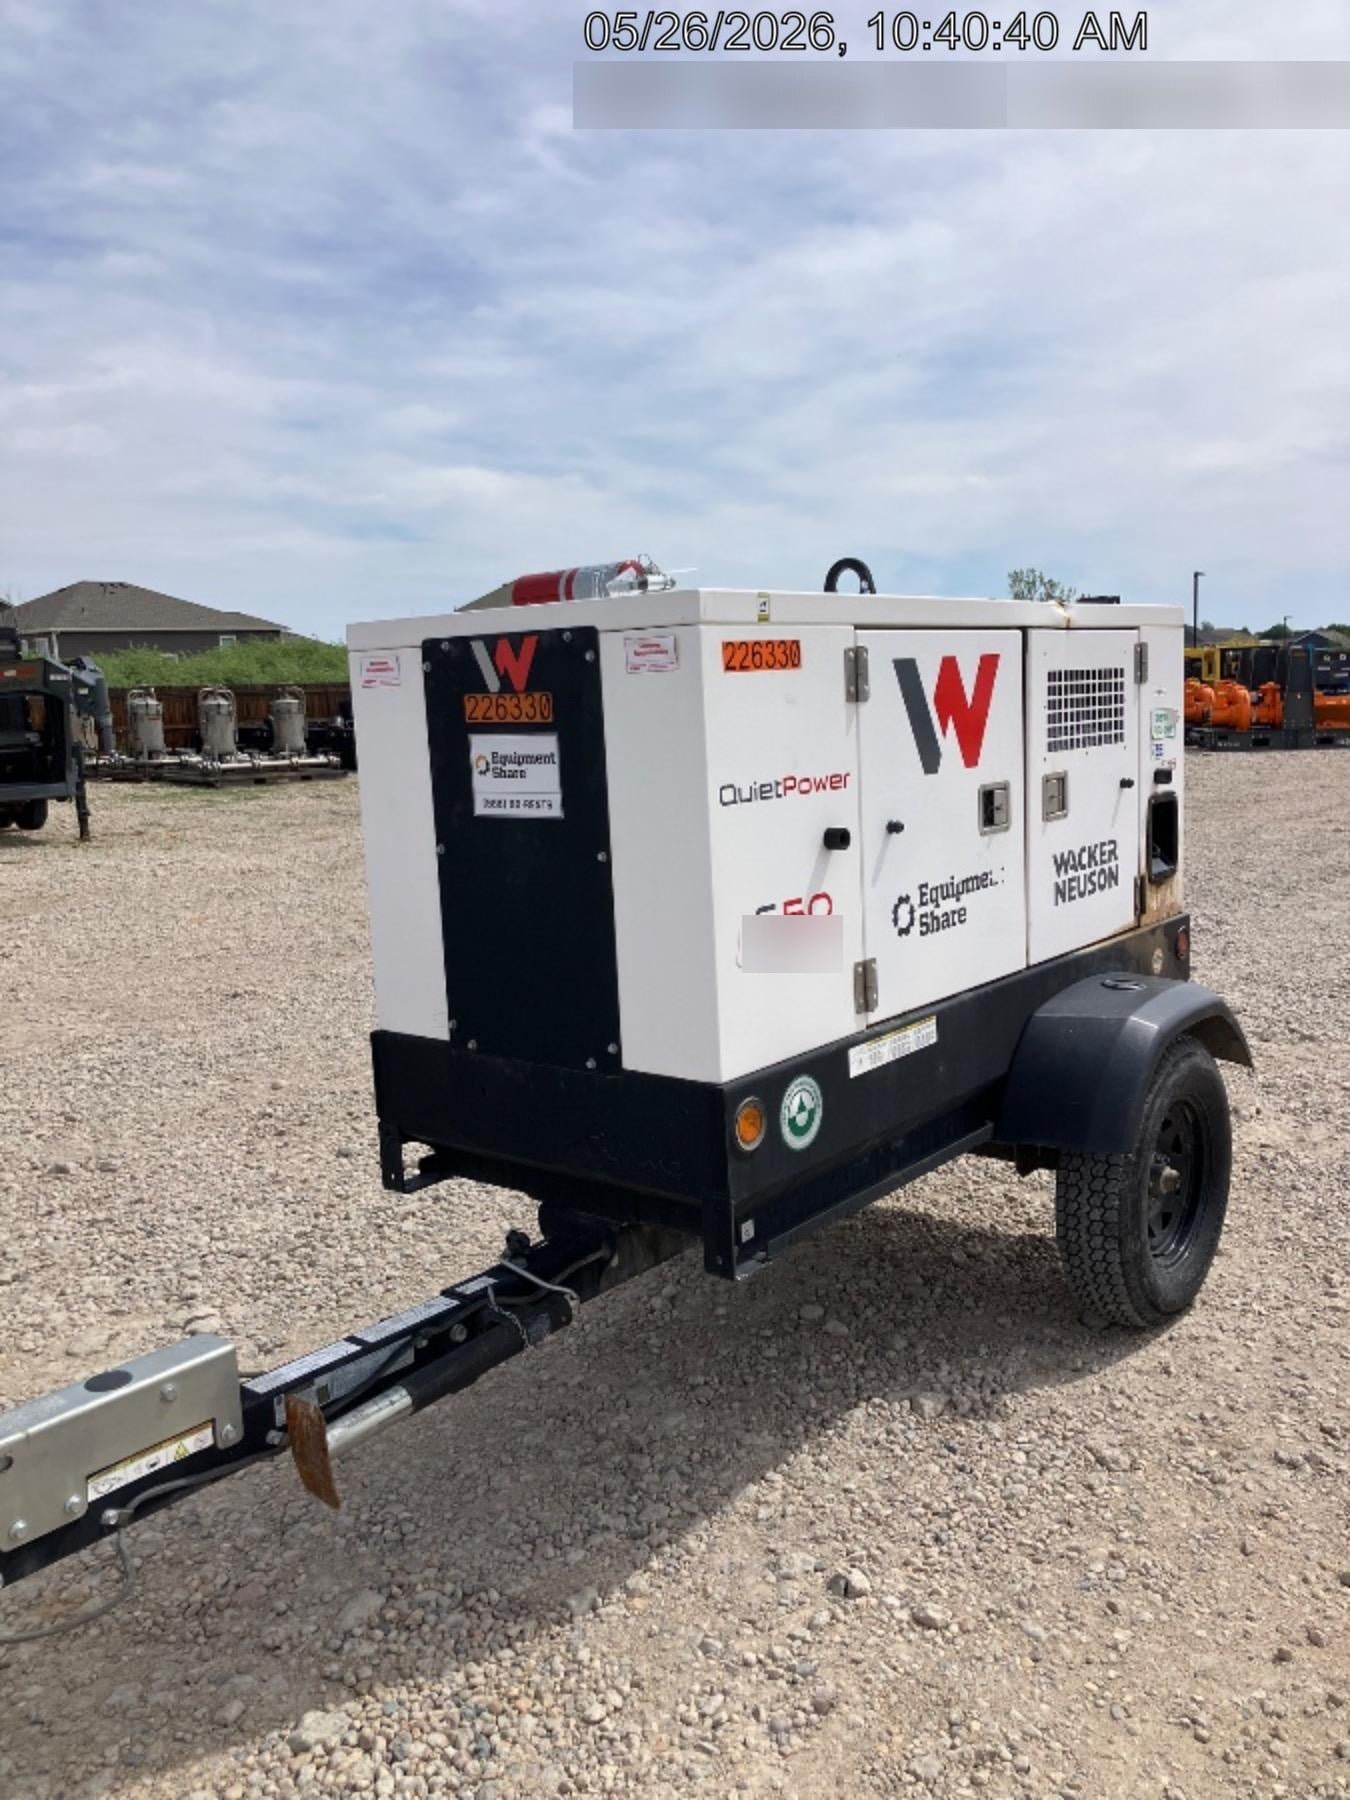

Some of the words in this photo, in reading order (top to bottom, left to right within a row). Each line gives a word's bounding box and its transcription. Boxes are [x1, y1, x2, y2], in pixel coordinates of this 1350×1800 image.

[724, 640, 801, 671] 226330
[467, 693, 551, 721] 226330
[491, 752, 556, 767] Equipment
[719, 772, 850, 807] QuietPower
[1053, 839, 1118, 878] WACKER
[1054, 863, 1119, 906] NEUSON
[919, 906, 967, 937] Share
